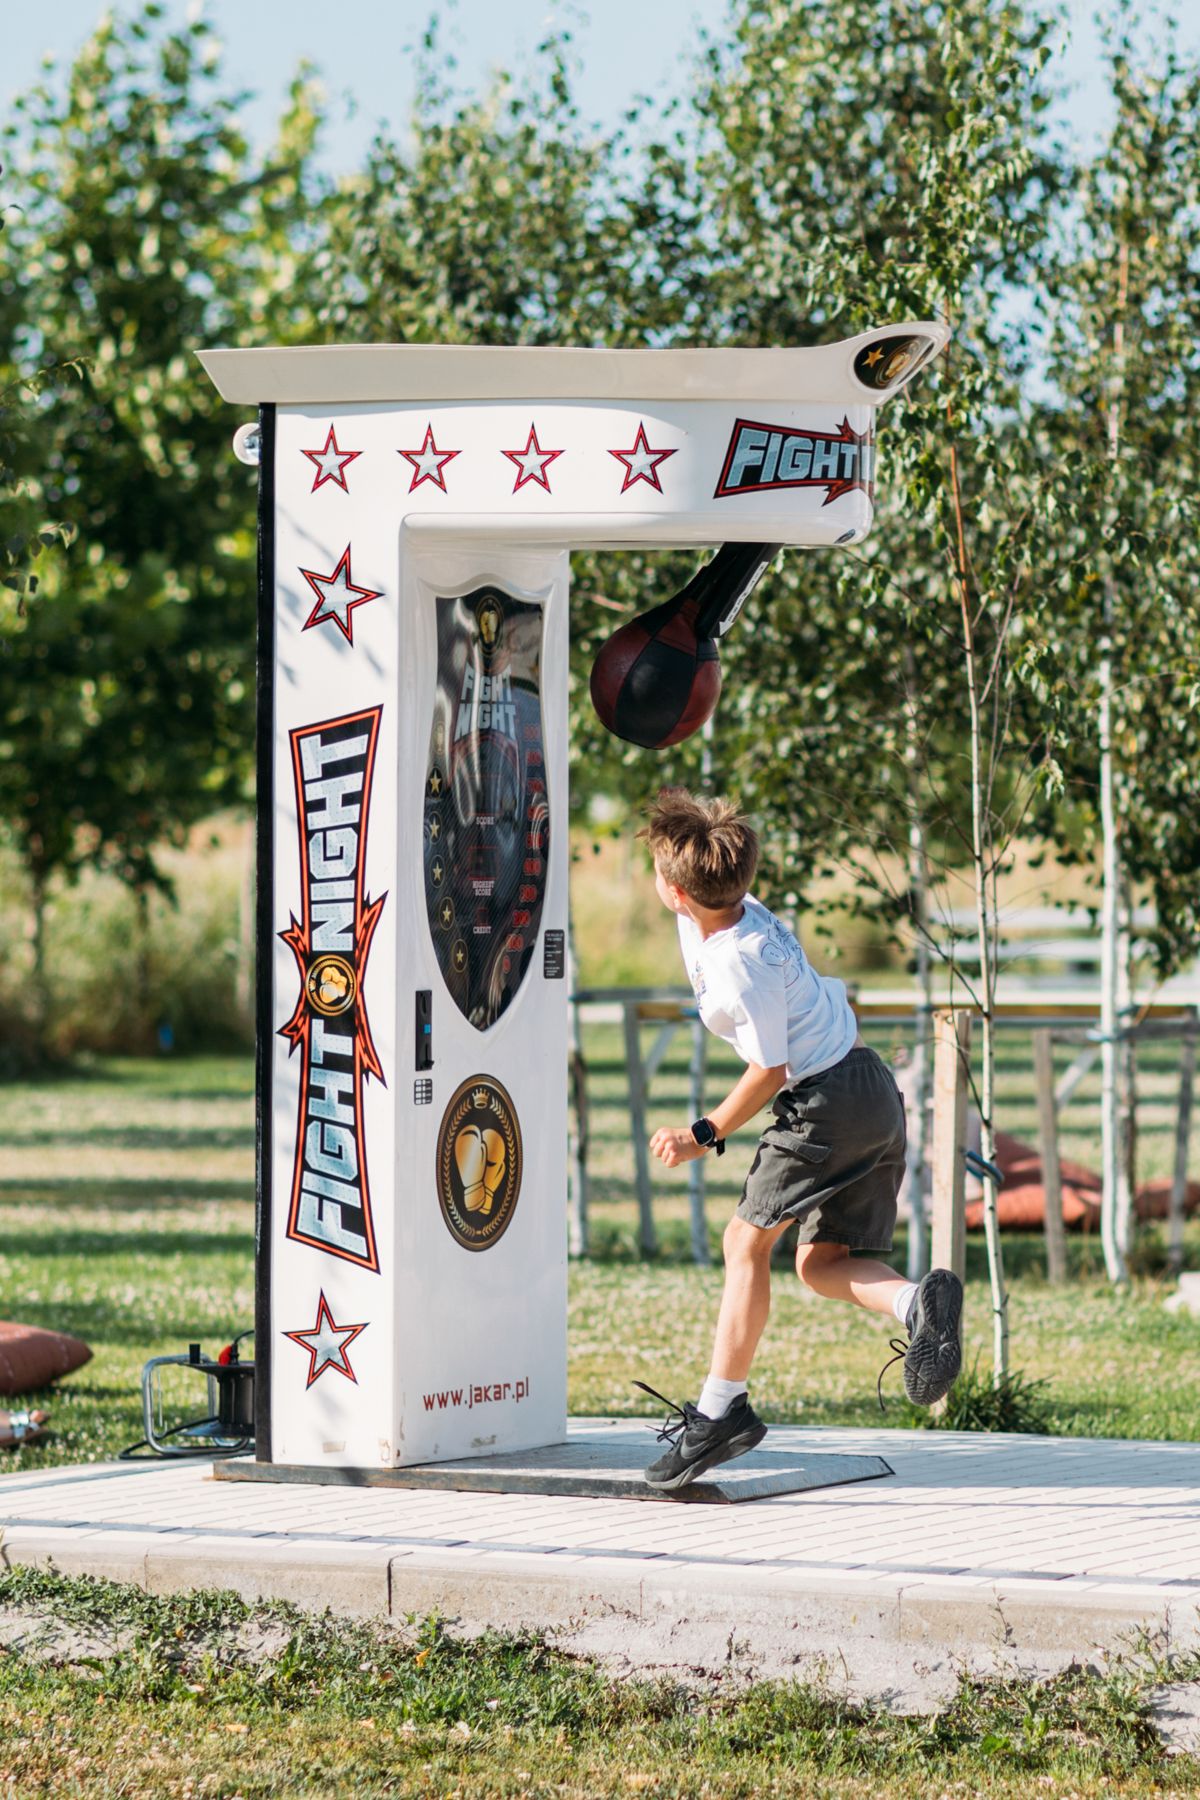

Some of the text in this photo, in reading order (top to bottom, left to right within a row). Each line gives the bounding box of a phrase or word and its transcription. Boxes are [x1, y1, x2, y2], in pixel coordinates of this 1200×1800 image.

[725, 427, 859, 488] FIGHT
[454, 703, 516, 742] NIGHT
[297, 733, 369, 1258] FIGHT NIGHT
[423, 1376, 529, 1411] www.jakar.pl
